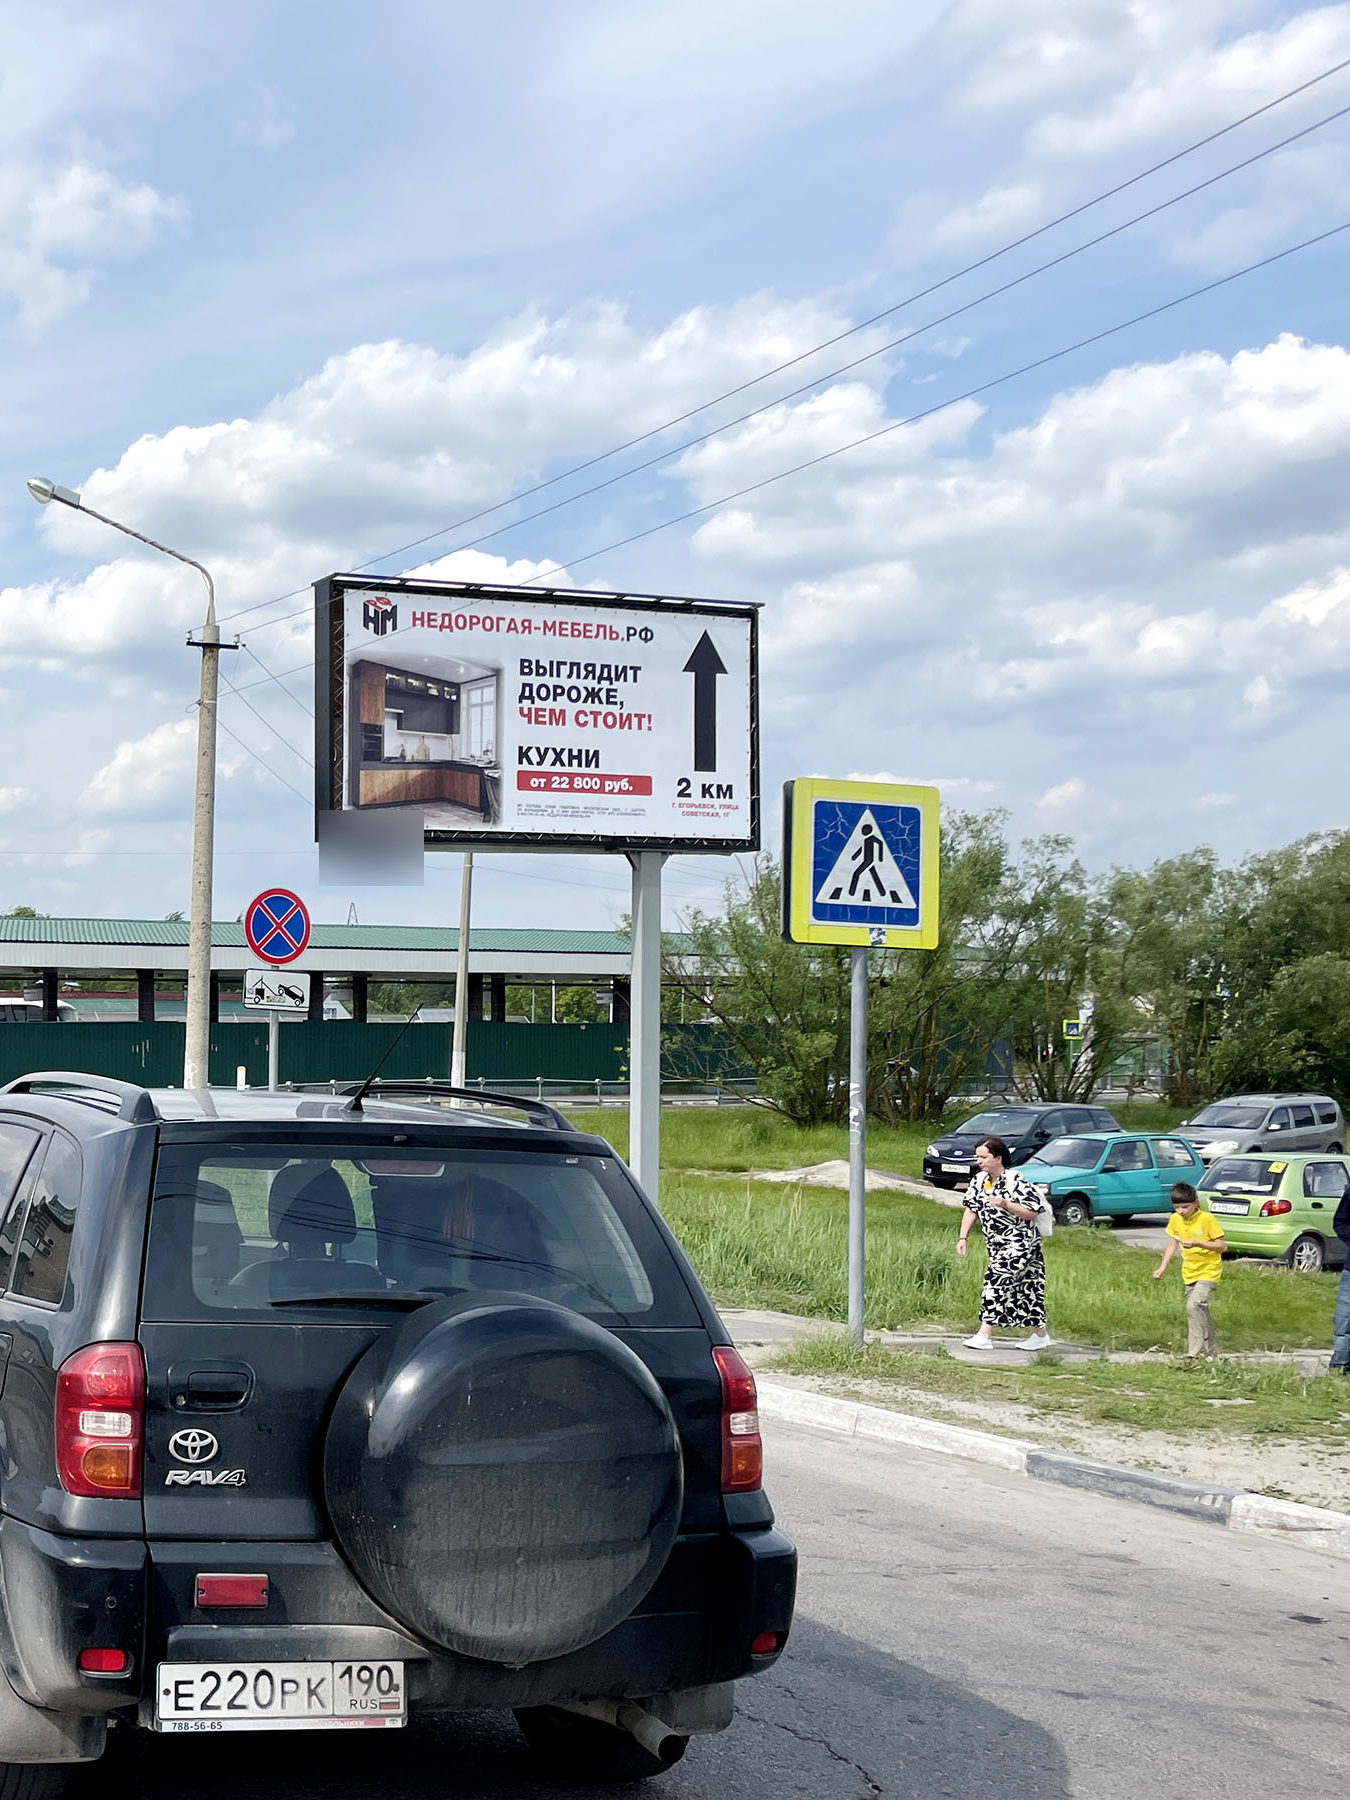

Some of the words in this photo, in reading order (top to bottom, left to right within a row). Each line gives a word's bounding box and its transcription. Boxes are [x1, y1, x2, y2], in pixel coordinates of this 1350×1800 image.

[412, 610, 654, 644] НЕДОРОГАЯ-МЕБЕЛЬ.РФ
[519, 658, 642, 685] ВЫГЛЯДИТ
[518, 683, 624, 710] ДОРОЖЕ,
[519, 706, 566, 726] ЧЕМ
[574, 709, 652, 731] СТОИТ!
[518, 746, 600, 769] КУХНИ
[530, 778, 547, 788] от
[551, 776, 570, 789] 22
[573, 777, 601, 790] 800
[604, 778, 634, 793] руб.
[676, 777, 692, 798] 2
[165, 1469, 246, 1486] RAV4
[174, 1669, 326, 1712] Е220РК
[338, 1665, 393, 1696] 190
[350, 1698, 378, 1710] RUS
[171, 1721, 223, 1731] 788-56-65
